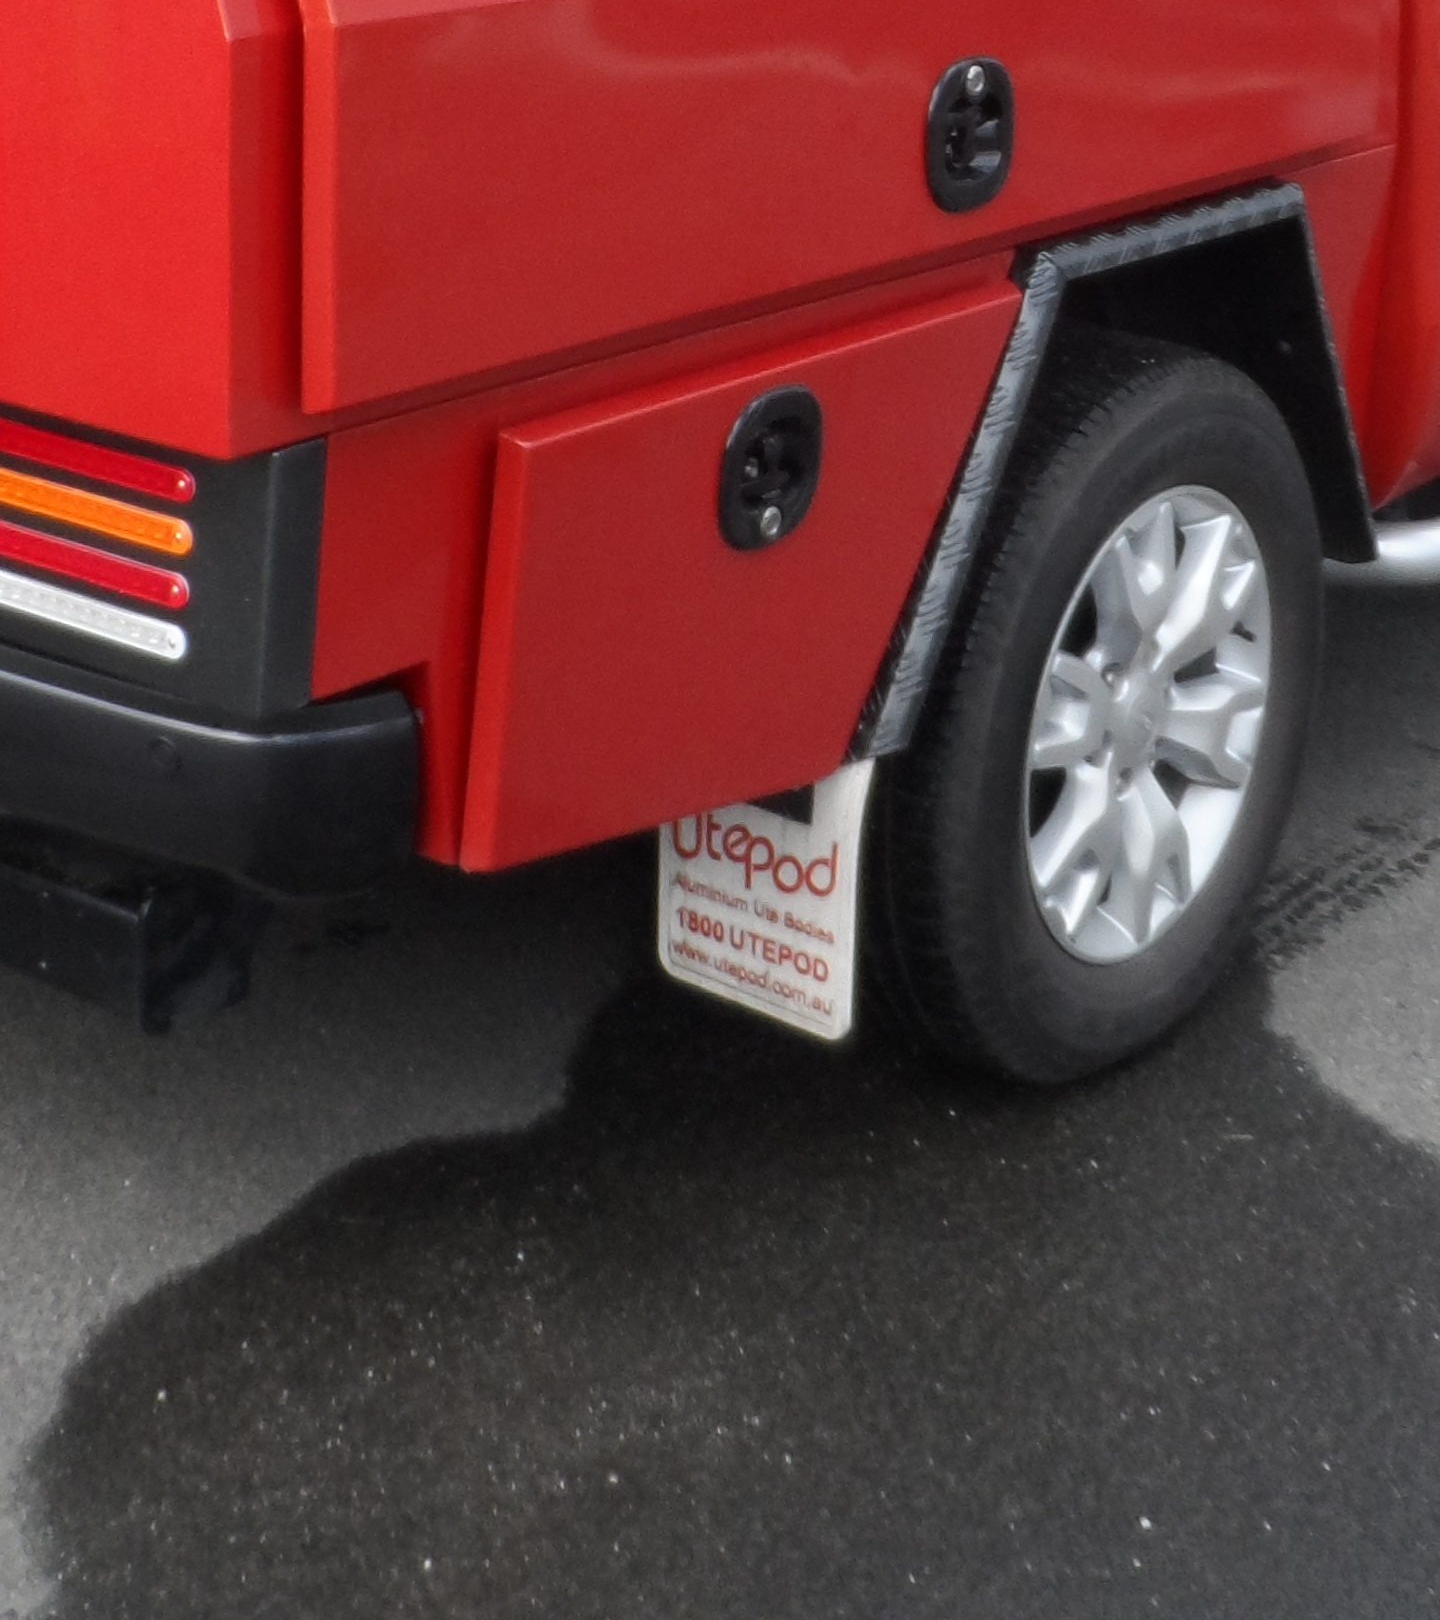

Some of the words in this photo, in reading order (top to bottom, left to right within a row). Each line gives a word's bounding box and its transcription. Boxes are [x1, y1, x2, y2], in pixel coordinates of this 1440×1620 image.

[673, 813, 839, 897] Utepod
[677, 906, 725, 943] 1800
[729, 924, 830, 983] UTEPOD
[753, 898, 779, 924] Ute
[783, 912, 835, 944] Bodies
